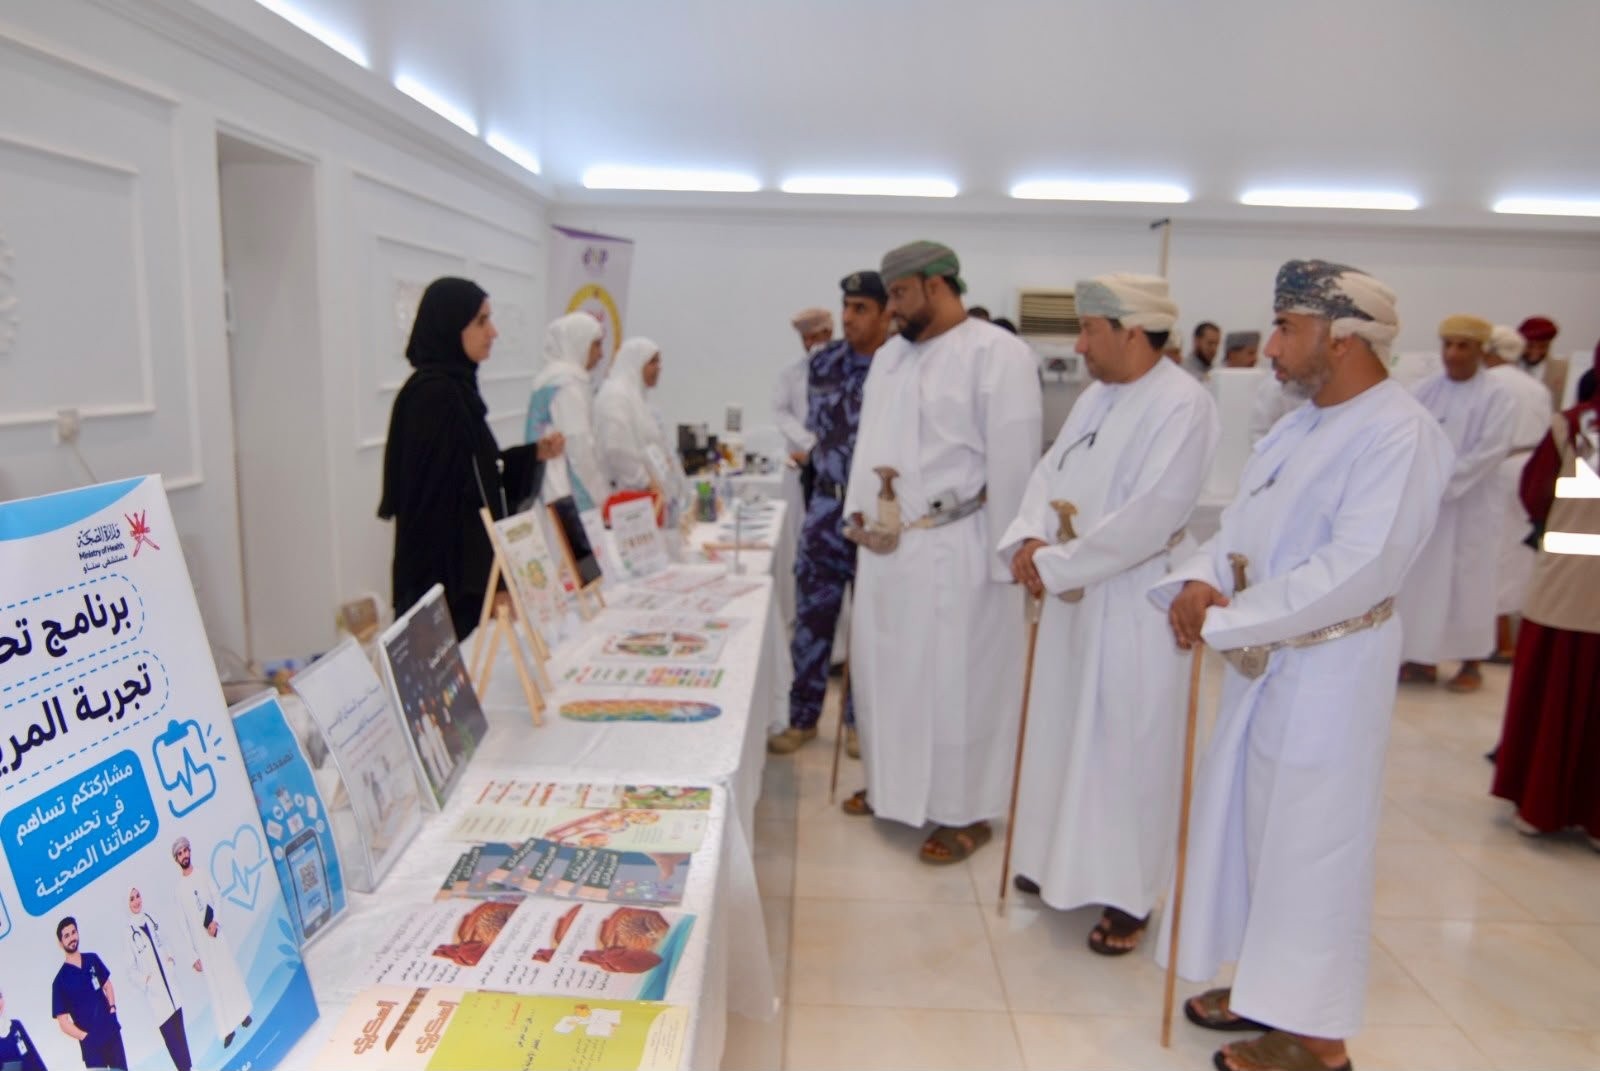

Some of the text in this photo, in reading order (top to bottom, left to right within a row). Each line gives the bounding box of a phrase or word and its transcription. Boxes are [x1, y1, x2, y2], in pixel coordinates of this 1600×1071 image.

[79, 542, 125, 560] Ministry of Health
[41, 594, 131, 657] برنامج
[0, 662, 152, 778] تجربة المري
[16, 764, 133, 846] مشاركتكم تساهم
[48, 794, 125, 860] في تحسين
[35, 814, 150, 897] خدماتنا الصحية
